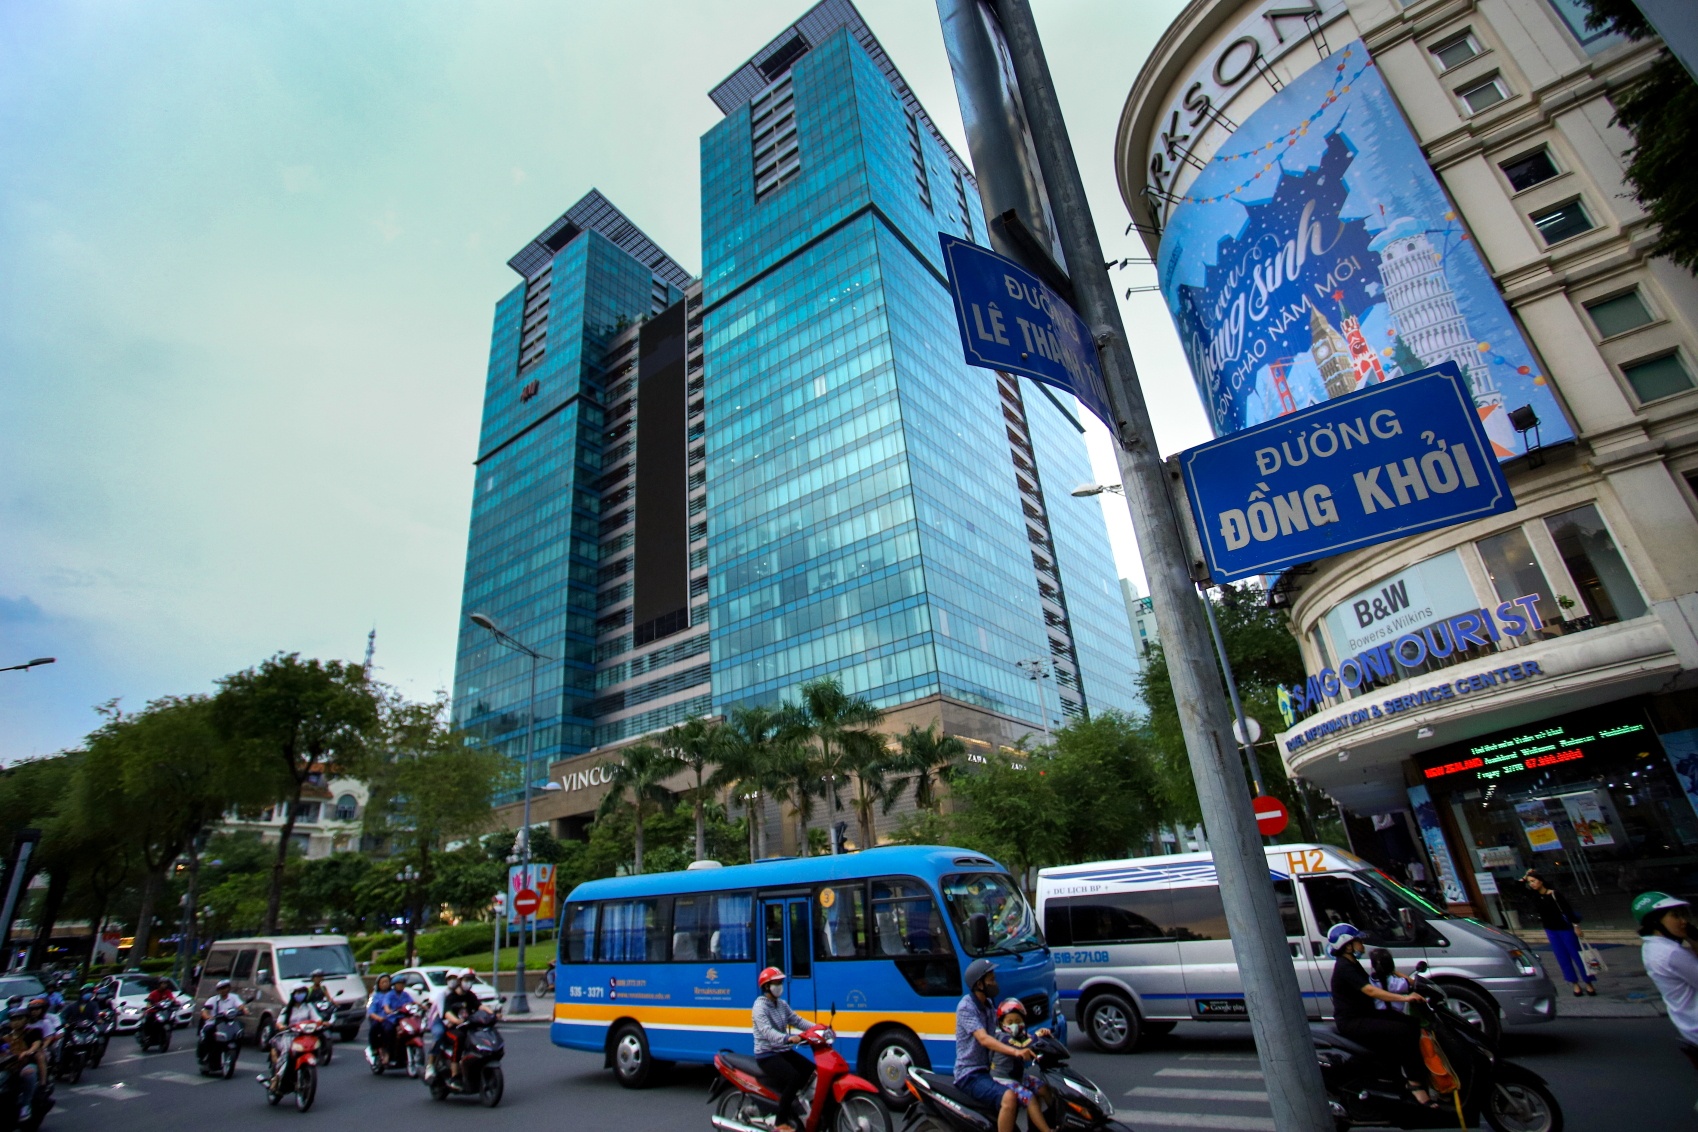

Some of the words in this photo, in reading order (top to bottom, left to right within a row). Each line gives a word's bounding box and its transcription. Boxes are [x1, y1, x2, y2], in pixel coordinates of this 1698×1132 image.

[1004, 274, 1080, 344] ĐƯỜNG
[1231, 339, 1266, 390] CHÀO
[1268, 294, 1312, 341] NĂM
[1314, 254, 1361, 298] MỚI
[971, 301, 1010, 347] LÊ
[1016, 317, 1085, 385] THÁNH
[1255, 409, 1403, 476] ĐƯỜNG
[1218, 482, 1340, 551] ĐỒNG
[1352, 430, 1480, 515] KHỞI
[1349, 628, 1386, 650] Bowers
[1386, 624, 1393, 635] &
[1392, 607, 1433, 631] Wilkins
[1353, 579, 1410, 629] B&W
[1304, 707, 1369, 742] INFORMATION
[1371, 704, 1382, 717] &
[1383, 682, 1455, 714] SERVICE
[1455, 660, 1544, 694] CENTER
[1053, 887, 1066, 895] DU
[1089, 885, 1102, 893] BP
[1285, 849, 1327, 873] H2
[1210, 1002, 1232, 1012] Google
